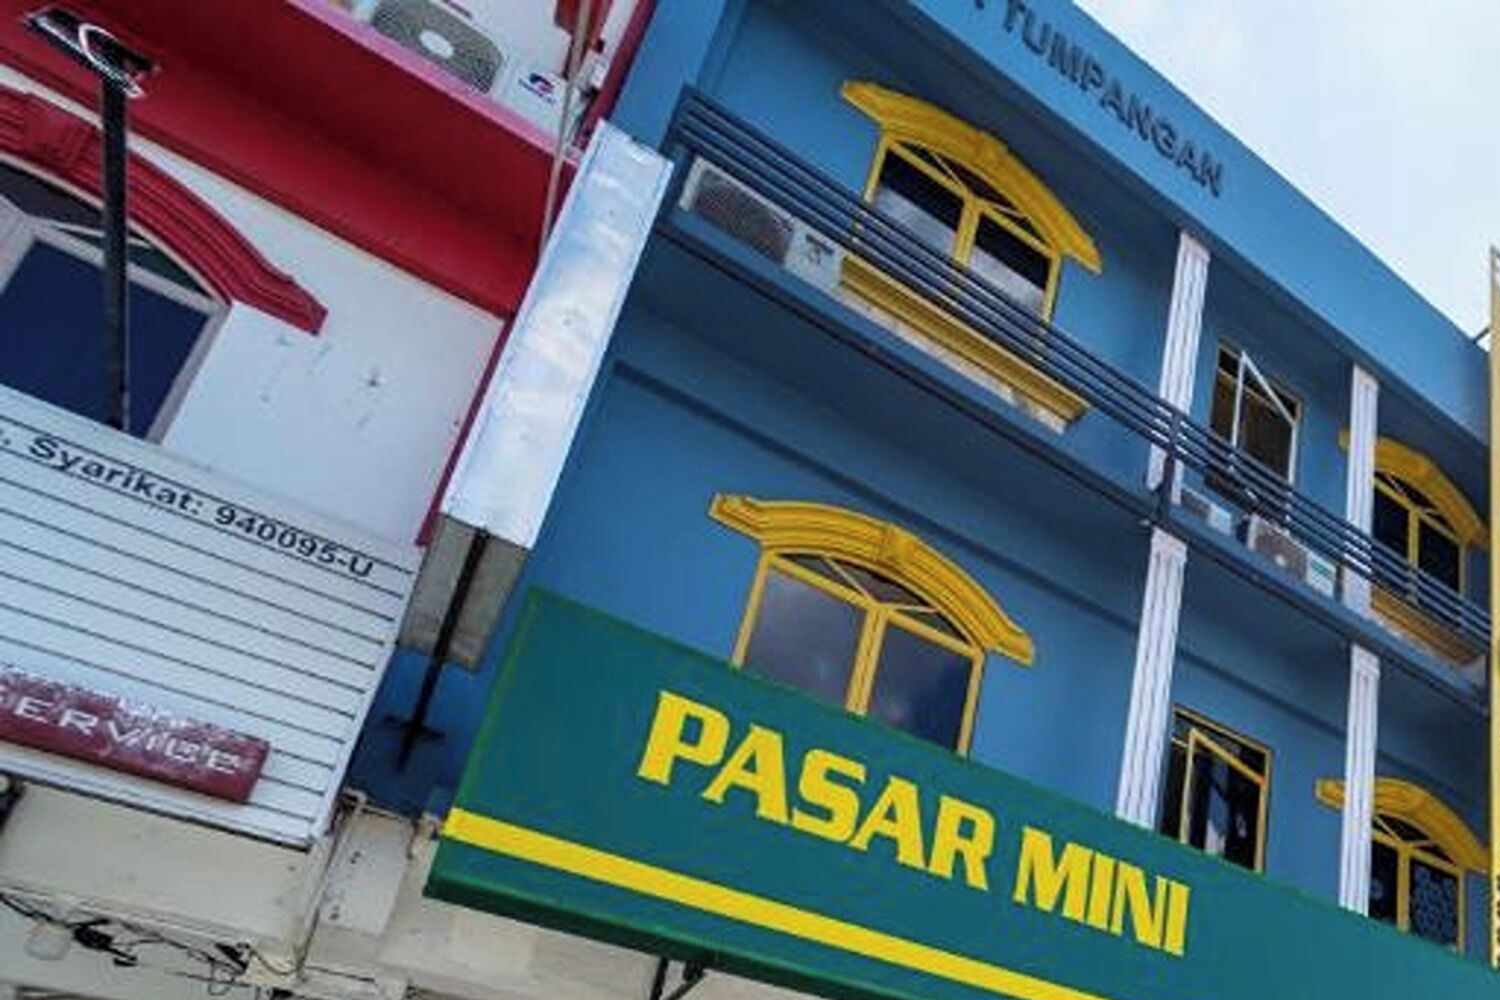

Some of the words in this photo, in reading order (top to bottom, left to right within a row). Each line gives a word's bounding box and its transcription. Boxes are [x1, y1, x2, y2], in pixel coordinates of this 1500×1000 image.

[1002, 0, 1224, 198] TUMPANGAN
[28, 436, 205, 515] Syarikat:
[213, 504, 375, 579] 940095-U
[636, 689, 997, 891] PASAR
[1013, 826, 1191, 957] MINI
